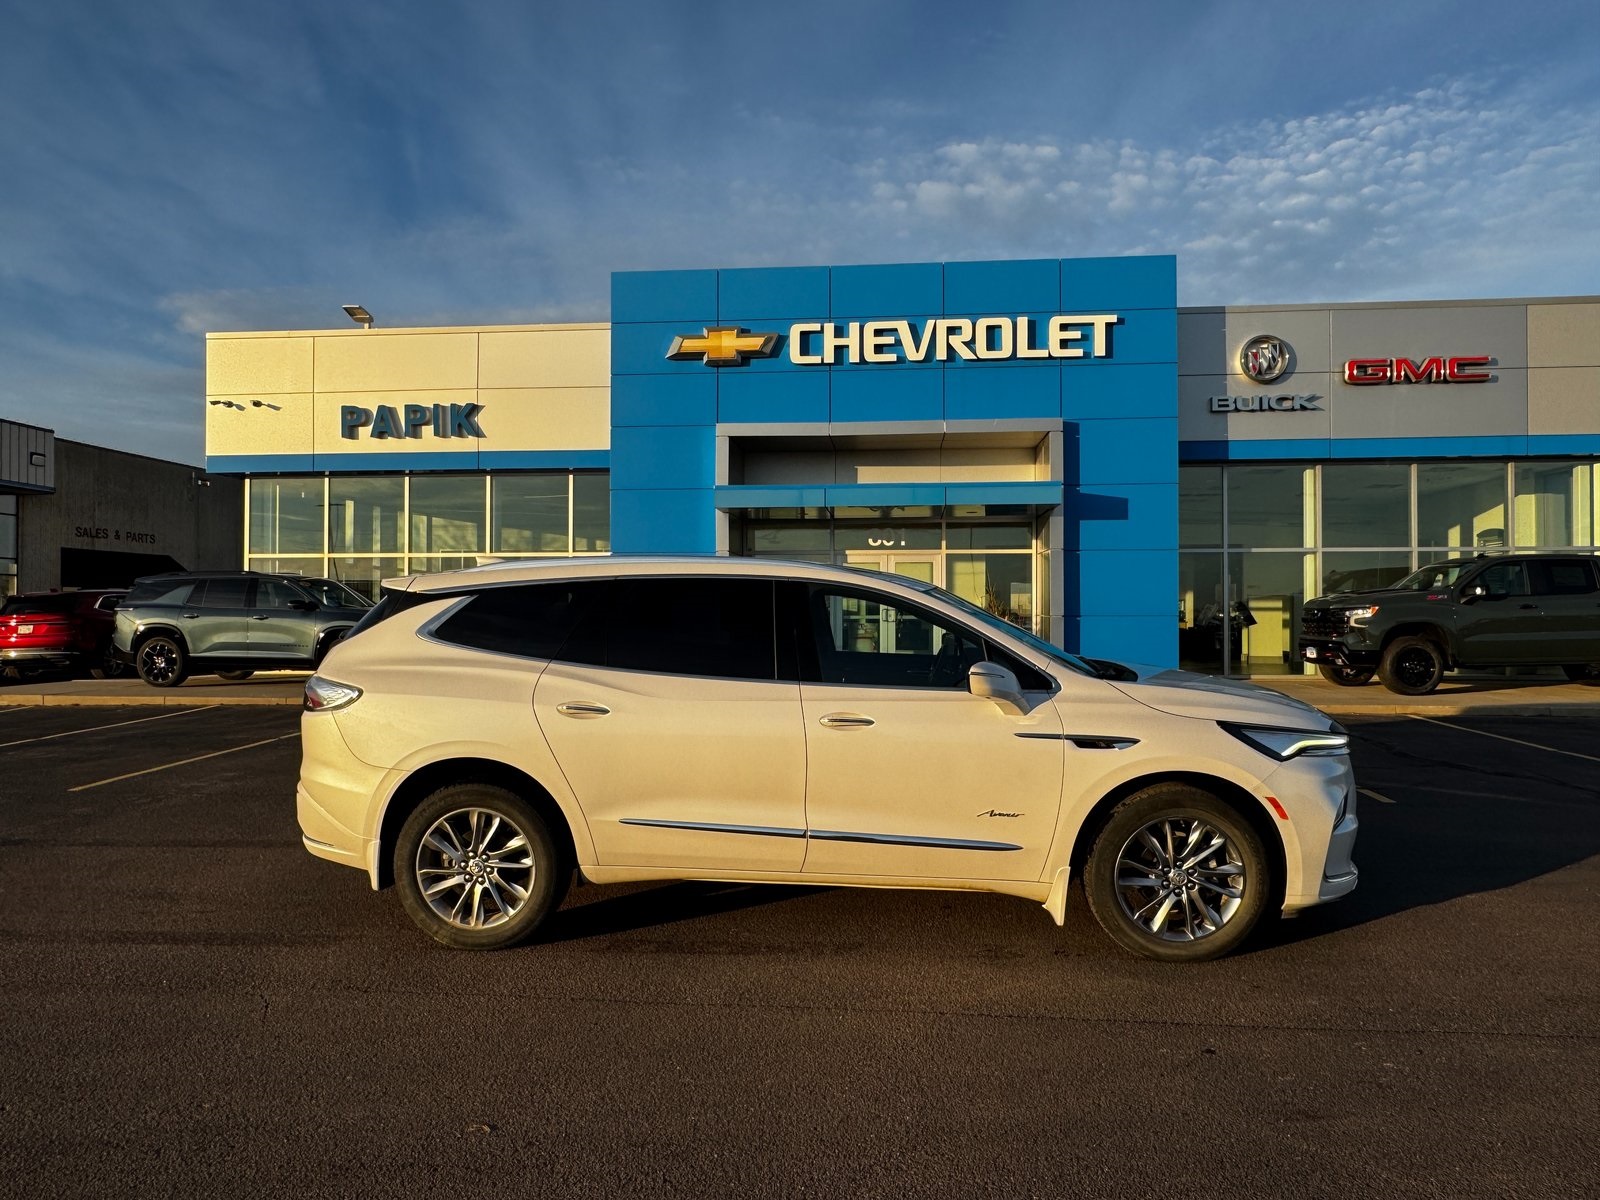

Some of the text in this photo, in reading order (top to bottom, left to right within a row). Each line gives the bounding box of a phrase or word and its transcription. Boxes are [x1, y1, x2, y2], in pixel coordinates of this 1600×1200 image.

[789, 314, 1118, 364] CHEVROLET
[1345, 355, 1492, 384] GMC
[1211, 394, 1321, 412] BUICK
[341, 403, 480, 438] PAPIK
[75, 526, 156, 544] SALES & PARTS
